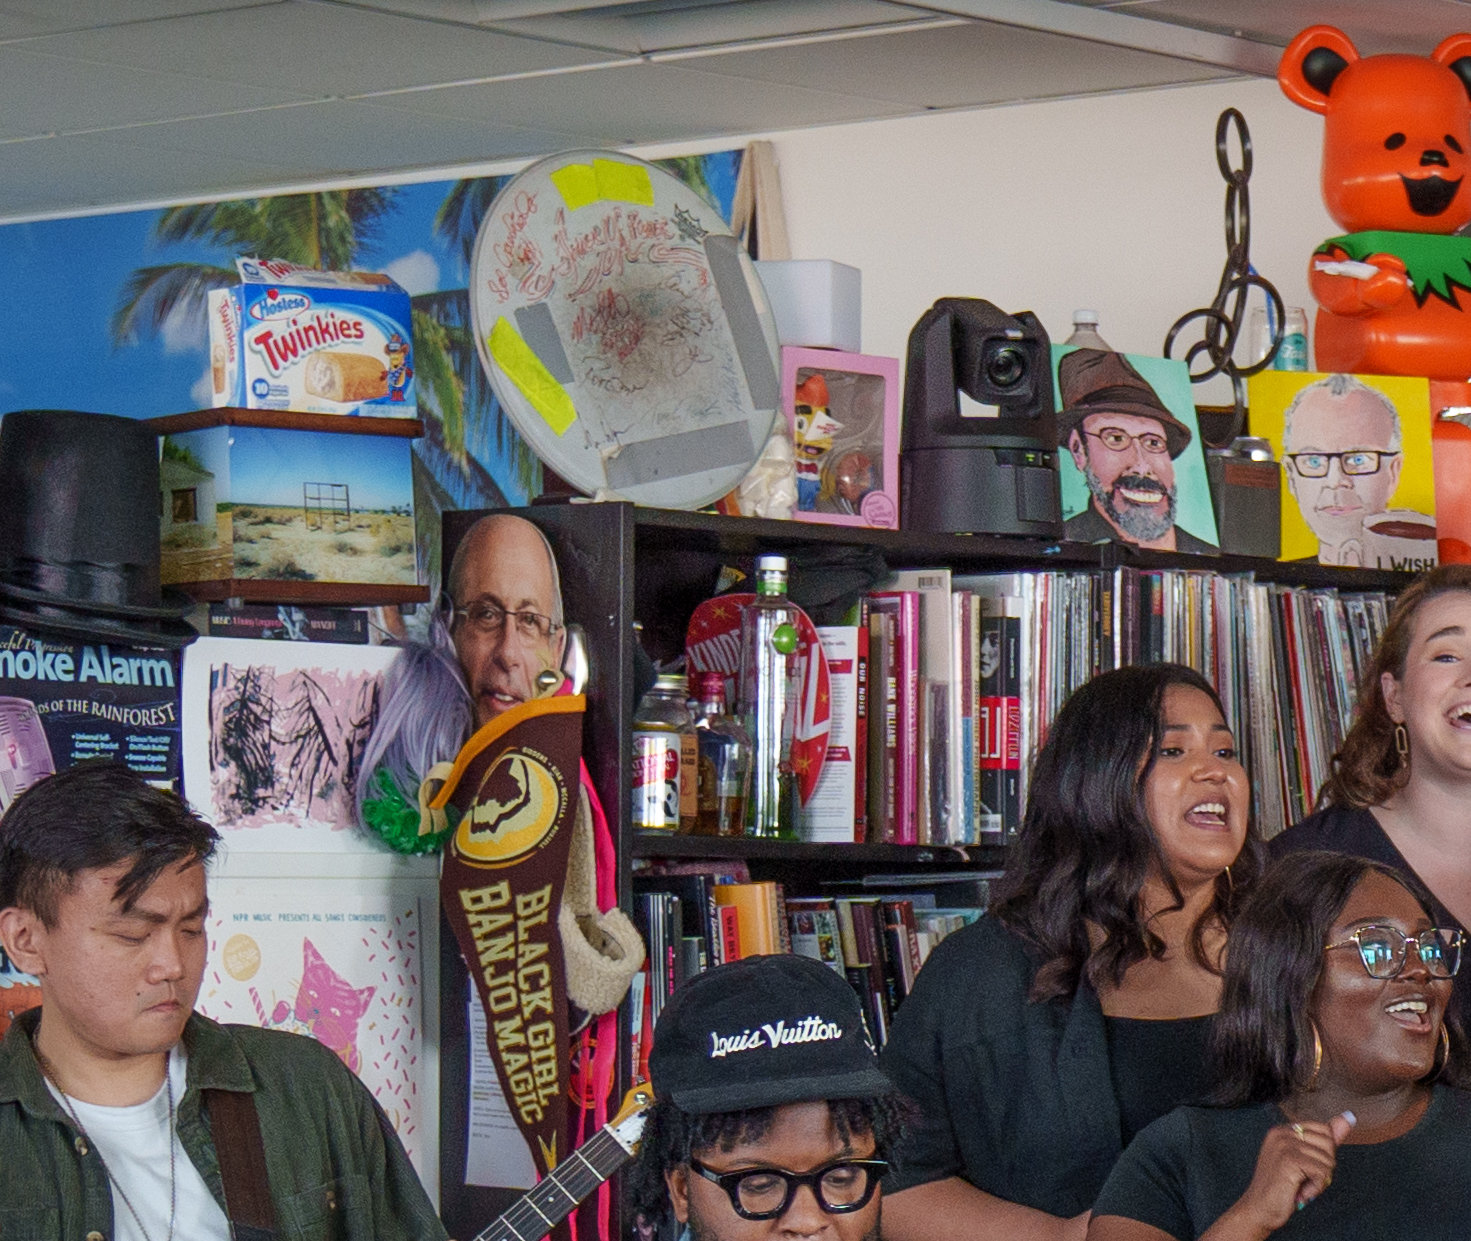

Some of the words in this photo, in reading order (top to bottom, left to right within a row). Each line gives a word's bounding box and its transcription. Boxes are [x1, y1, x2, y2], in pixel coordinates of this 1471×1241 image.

[258, 294, 306, 318] Hostess
[220, 297, 236, 363] Twinkies
[254, 312, 365, 372] Twinkies
[1390, 556, 1435, 572] WISH
[79, 645, 175, 688] Alarm
[858, 661, 867, 683] OUR
[887, 676, 896, 700] HANK
[51, 700, 64, 712] OF
[66, 700, 89, 714] THE
[92, 701, 176, 727] RAINFOREST
[886, 703, 896, 748] WILLIAMS
[233, 913, 248, 922] NPR
[725, 916, 735, 938] WAY
[516, 883, 554, 1015] BLACK
[458, 879, 516, 1015] BANJO
[494, 1014, 544, 1126] MAGIC
[710, 1029, 767, 1058] Louis
[762, 1015, 842, 1048] Vuitton
[525, 1018, 560, 1107] GIRL
